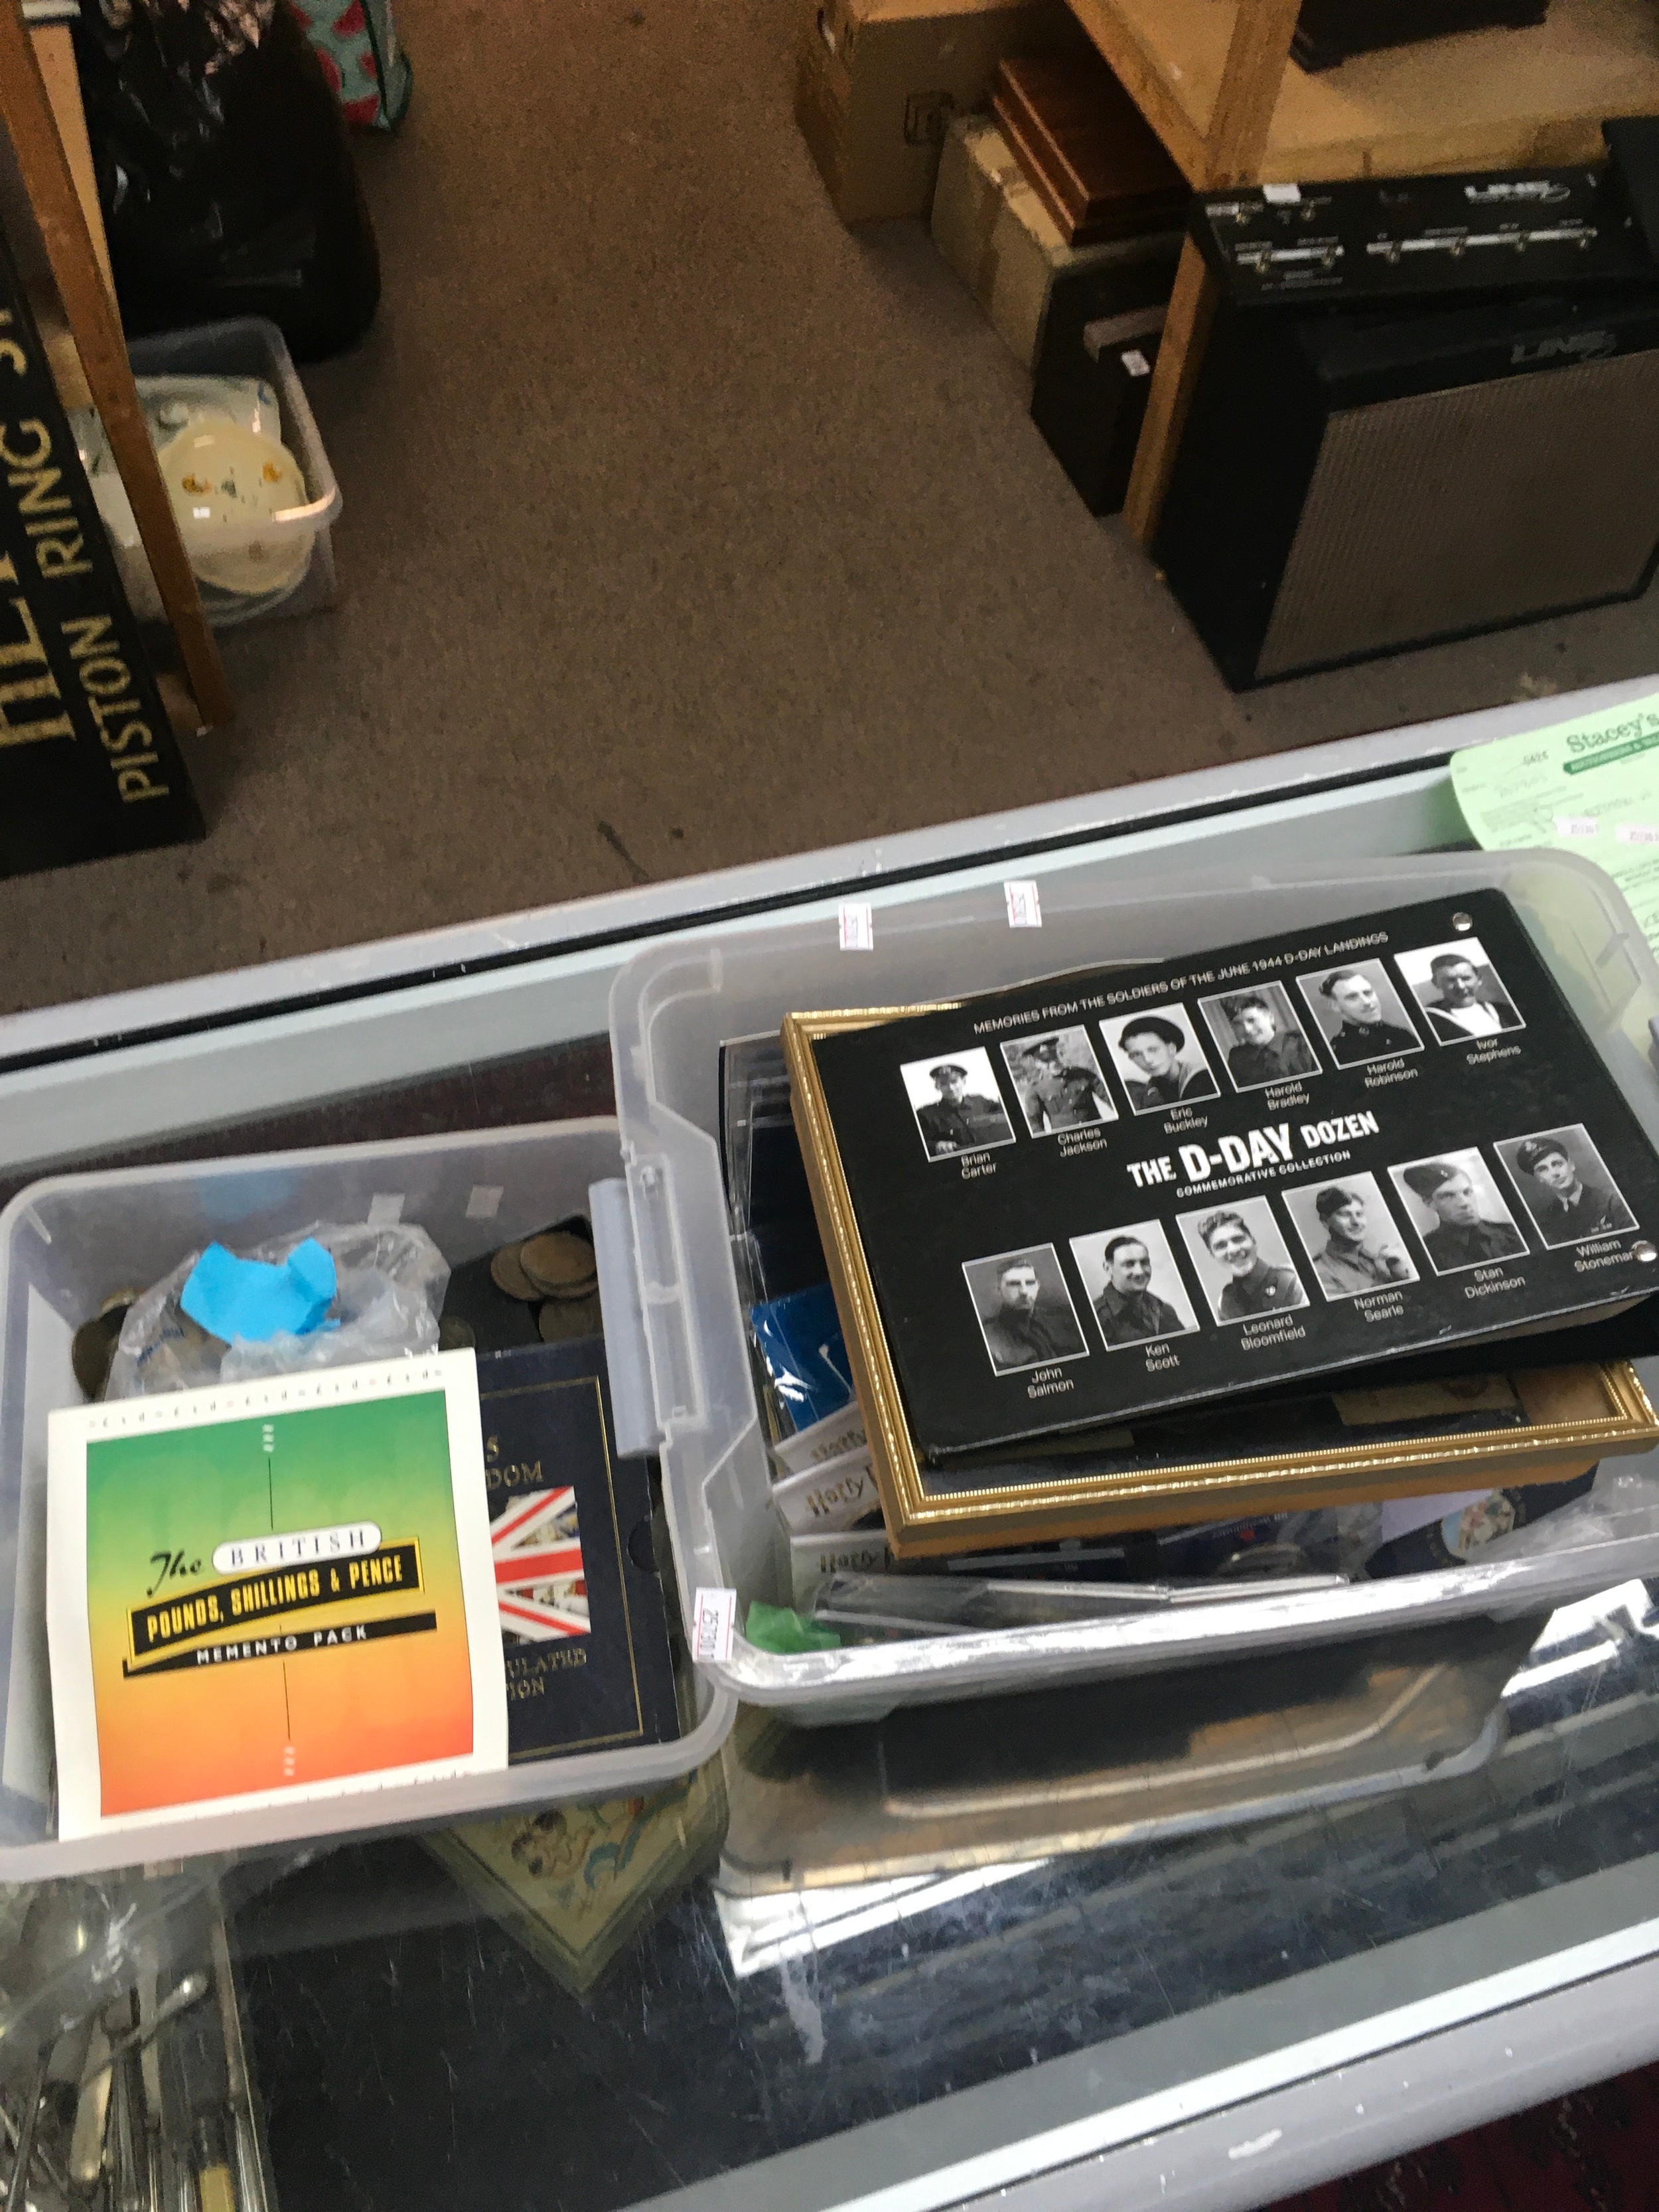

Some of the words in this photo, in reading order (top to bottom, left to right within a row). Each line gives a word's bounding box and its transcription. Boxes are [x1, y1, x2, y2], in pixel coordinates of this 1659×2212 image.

[62, 615, 170, 803] PISTON
[974, 1009, 1040, 1035] MEMORIES
[1042, 1001, 1078, 1019] FROM
[1079, 995, 1106, 1011] THE
[1107, 980, 1169, 1005] SOLDIERS
[1171, 976, 1187, 991] OF
[1189, 970, 1216, 986] THE
[1218, 962, 1251, 980] JUNE
[1252, 955, 1283, 972] 1944
[1284, 945, 1321, 965] D-DAY
[1324, 931, 1389, 956] LANDINGS
[1366, 1057, 1406, 1075] Harold
[1364, 1067, 1419, 1088] Robinson
[1265, 1081, 1303, 1098] Harold
[1267, 1093, 1310, 1111] Bradley
[1170, 1107, 1193, 1121] Eric
[1164, 1115, 1208, 1134] Buckley
[1057, 1128, 1101, 1145] Charles
[1060, 1138, 1108, 1157] Jackson
[1126, 1155, 1177, 1188] THE
[1179, 1122, 1294, 1183] D-DAY
[1300, 1110, 1380, 1149] DOZEN
[962, 1152, 991, 1167] Brian
[962, 1162, 997, 1179] Carter
[1176, 1166, 1277, 1199] COMMEMORATIVE
[1279, 1149, 1351, 1176] COLLECTION
[1576, 1240, 1621, 1258] William
[1474, 1266, 1504, 1282] Stan
[1464, 1276, 1526, 1299] Dickinson
[1354, 1291, 1403, 1311] Norman
[1364, 1305, 1404, 1323] Searle
[1243, 1314, 1293, 1336] Leonard
[1241, 1325, 1307, 1351] Bloomfield
[1145, 1343, 1170, 1358] Ken
[1145, 1354, 1181, 1372] Scott
[1031, 1366, 1062, 1384] John
[1027, 1378, 1074, 1399] Salmon
[485, 1459, 544, 1491] DOM
[145, 1548, 204, 1597] The
[231, 1528, 366, 1570] BRITISH
[145, 1594, 224, 1645] POUNDS,
[230, 1568, 321, 1616] SHILLINGS
[330, 1567, 340, 1593] &
[349, 1554, 403, 1589] PENCE
[196, 1635, 298, 1665] MEMENTO
[313, 1624, 368, 1648] PACK
